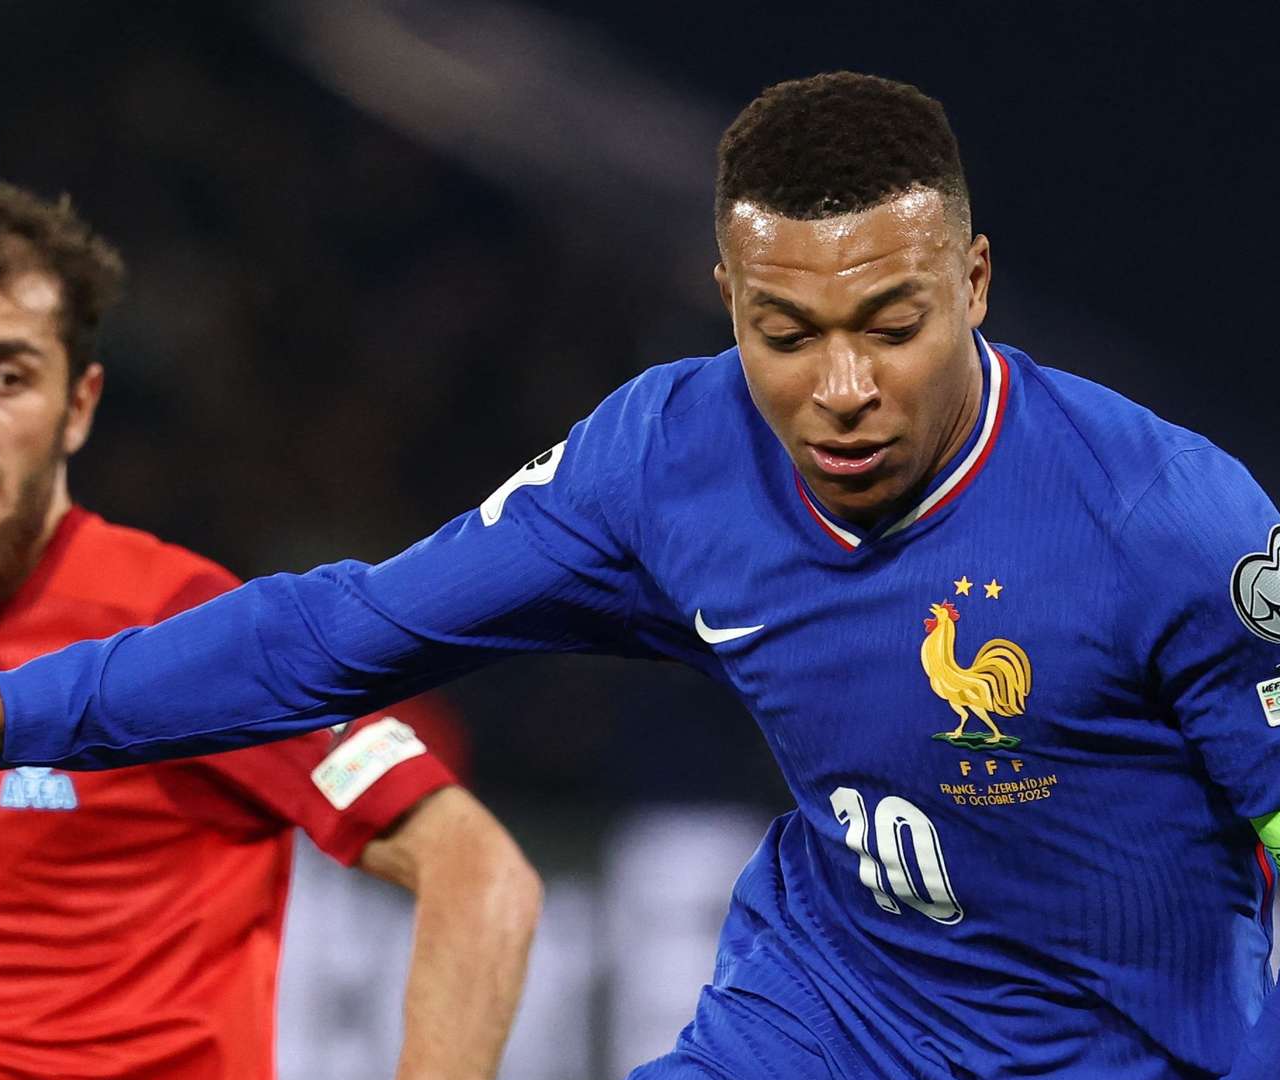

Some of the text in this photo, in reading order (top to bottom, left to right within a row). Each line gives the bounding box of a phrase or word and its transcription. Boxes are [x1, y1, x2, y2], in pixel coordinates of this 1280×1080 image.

[939, 783, 976, 795] FRANCE
[987, 774, 1058, 795] AZERBAÏDJAN
[953, 787, 1051, 806] 10 OCTOBRE 2025
[829, 786, 964, 925] 10
